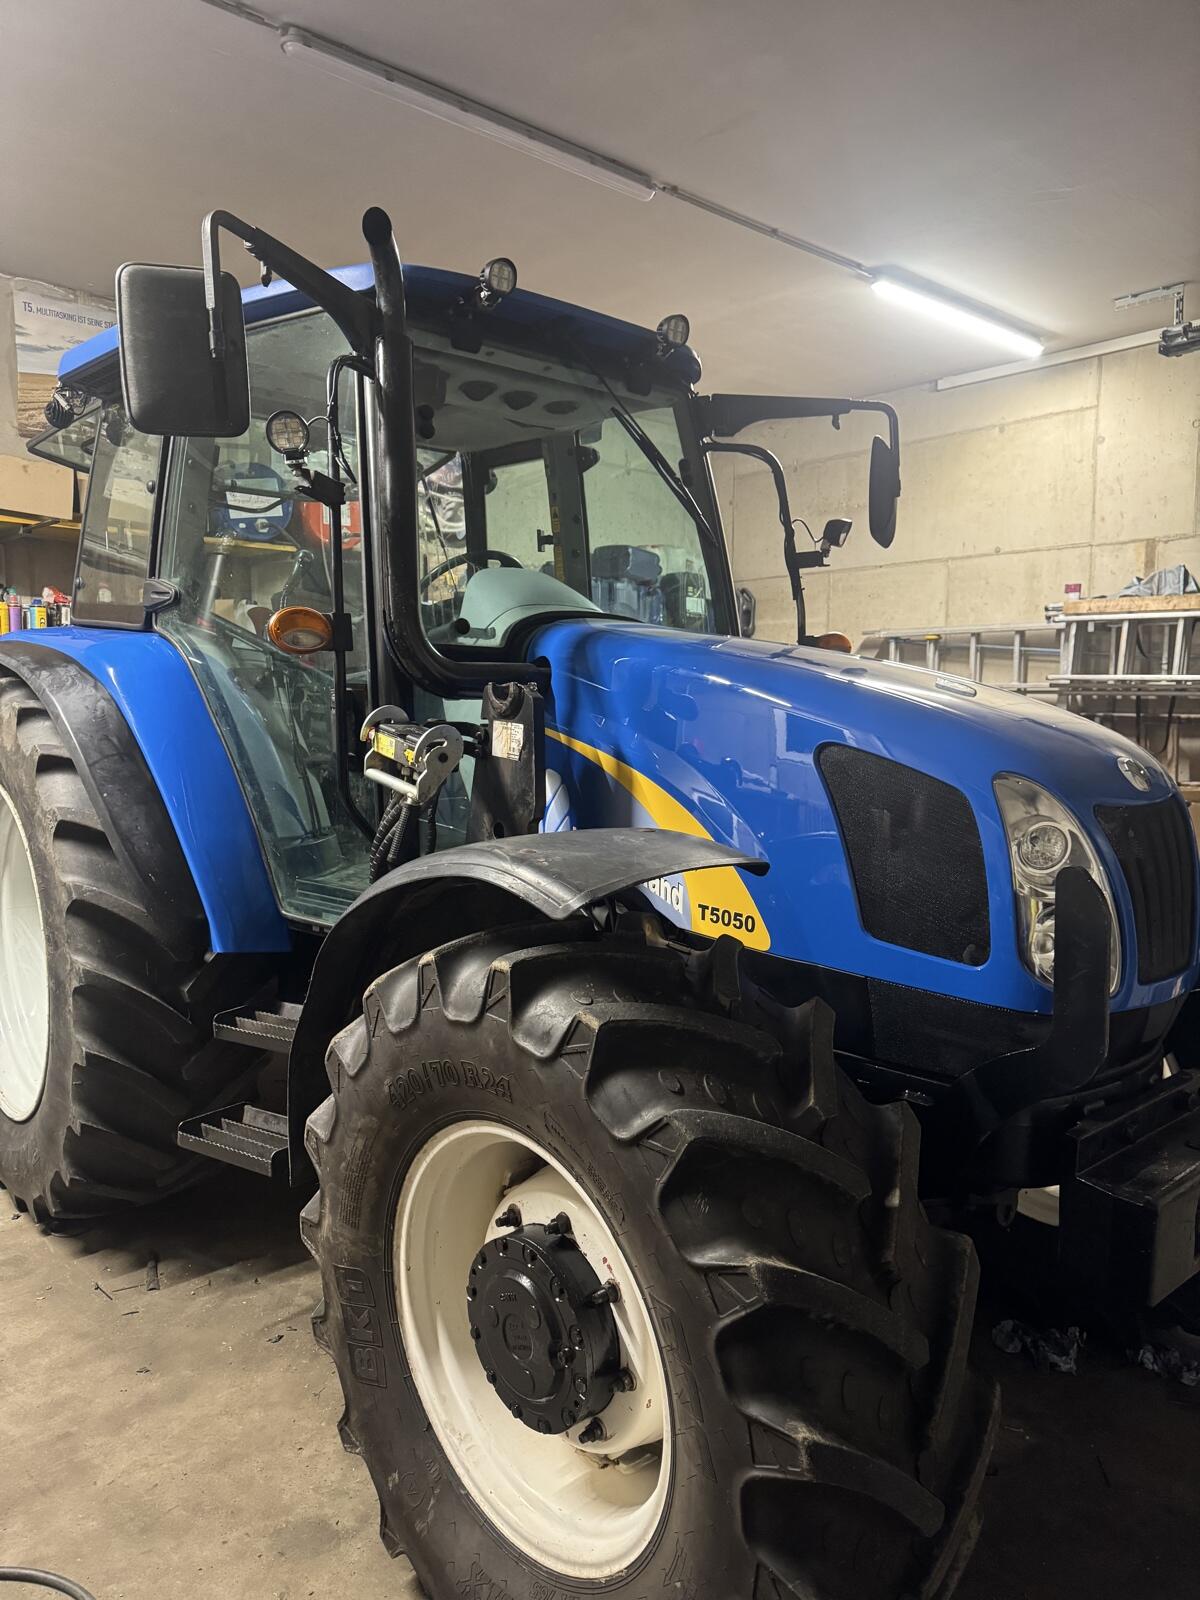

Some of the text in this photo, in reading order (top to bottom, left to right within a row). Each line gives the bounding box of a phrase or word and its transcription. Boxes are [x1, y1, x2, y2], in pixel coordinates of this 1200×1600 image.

[36, 307, 77, 322] MULTITASKING
[77, 315, 86, 324] IST
[87, 317, 104, 328] SEINE
[697, 903, 756, 934] T5050
